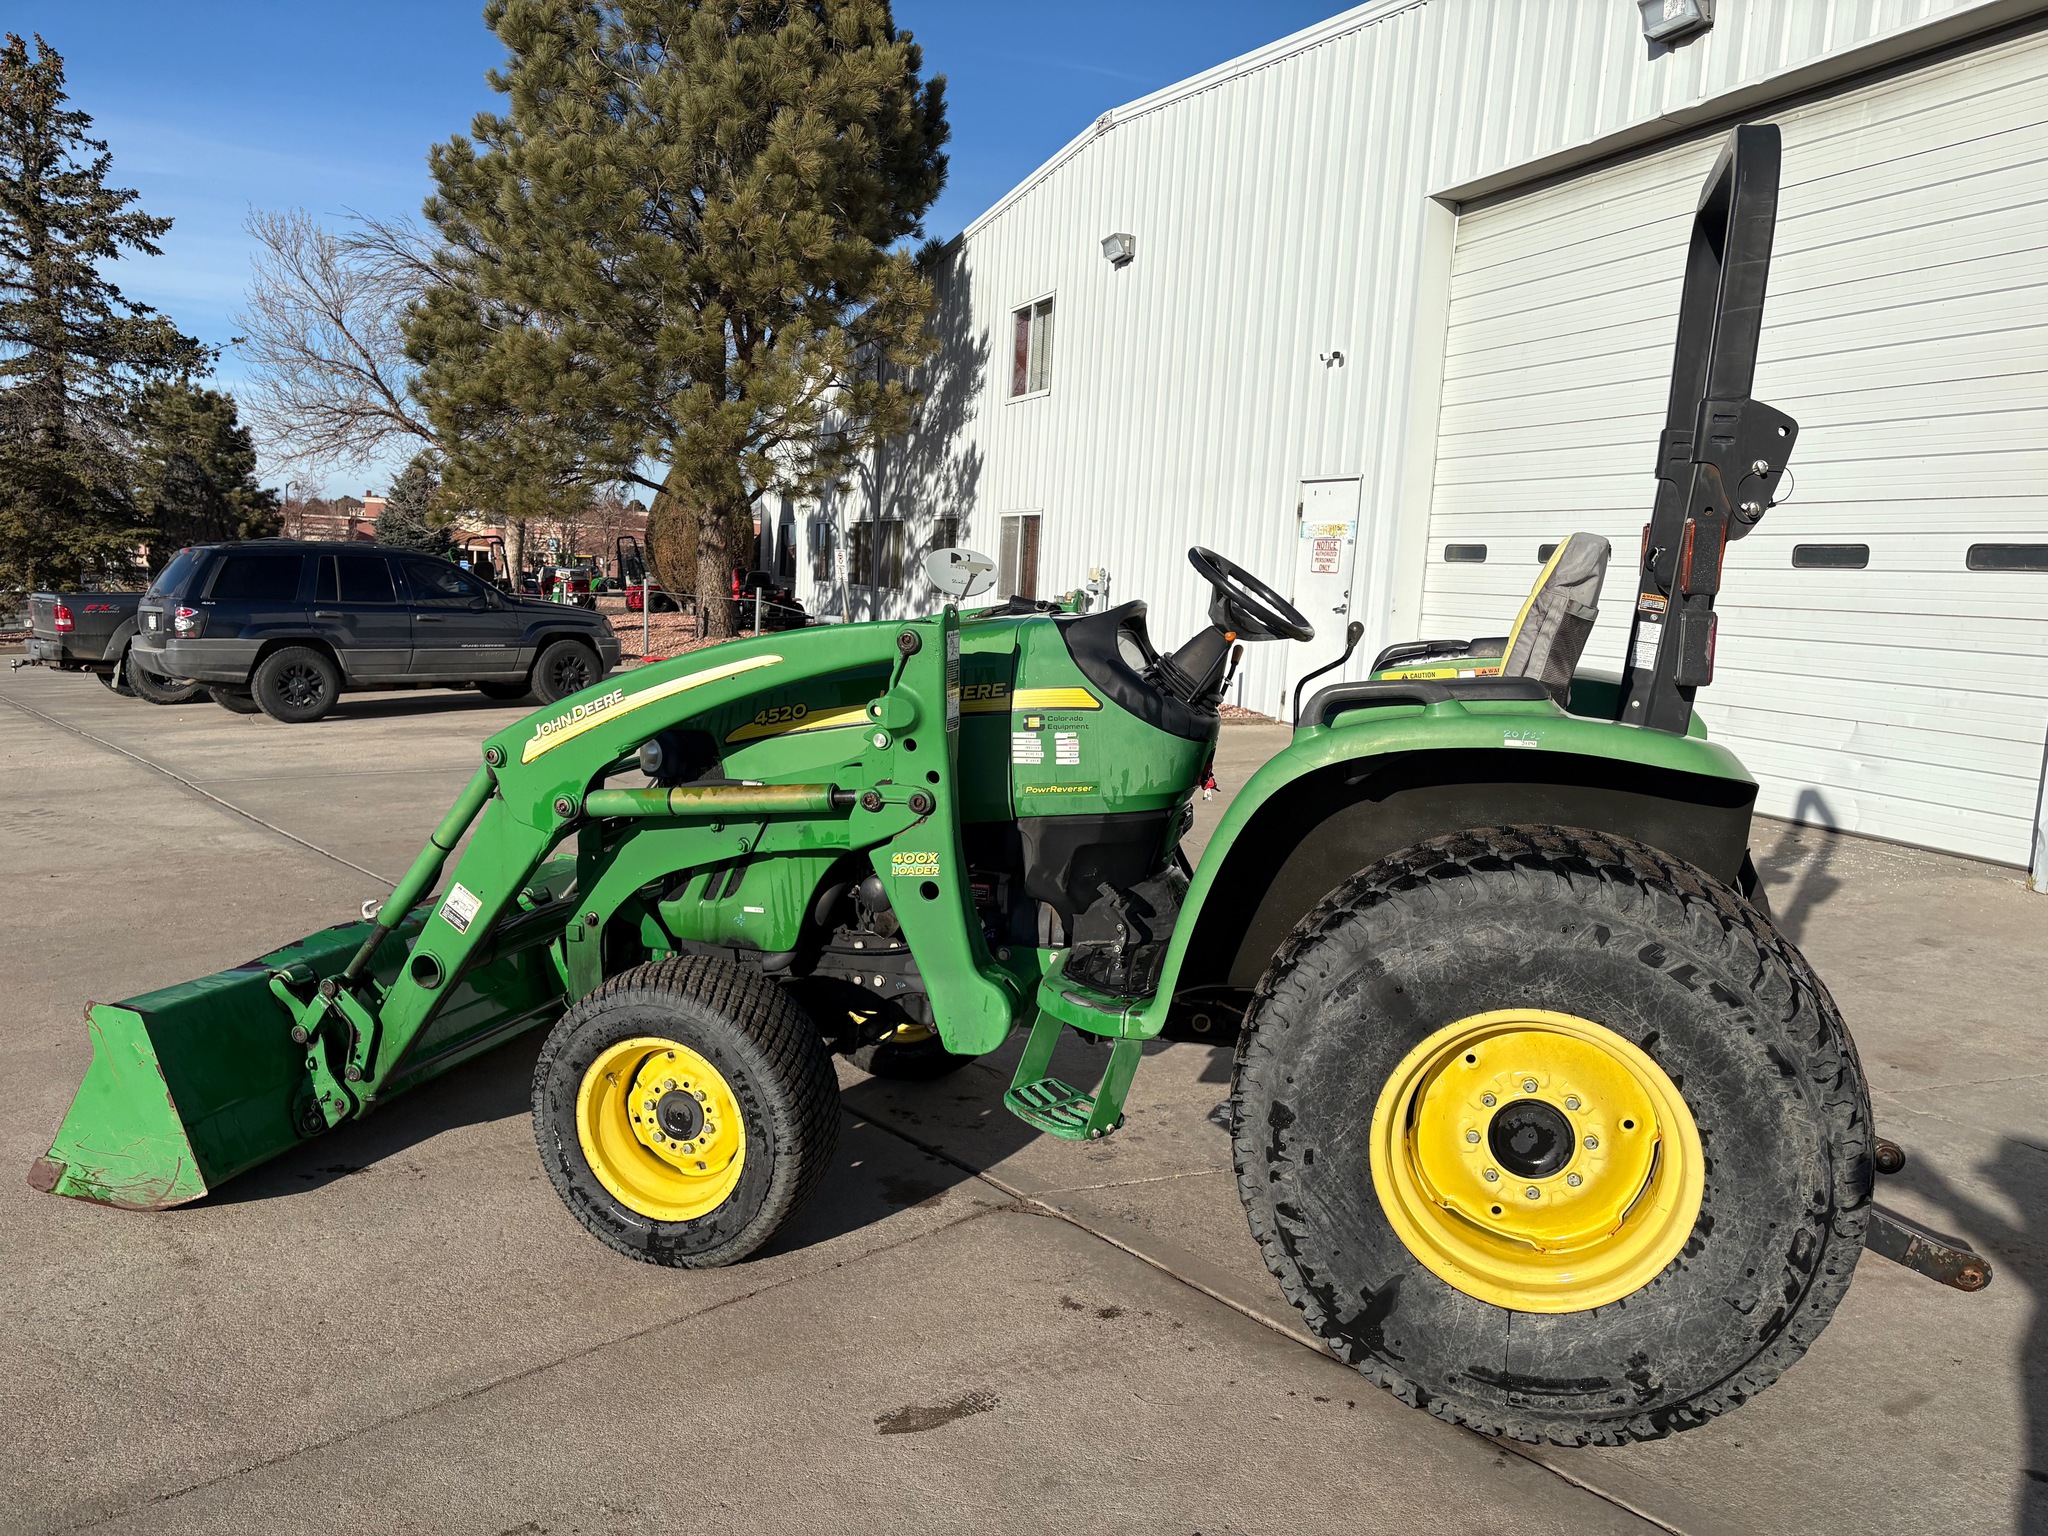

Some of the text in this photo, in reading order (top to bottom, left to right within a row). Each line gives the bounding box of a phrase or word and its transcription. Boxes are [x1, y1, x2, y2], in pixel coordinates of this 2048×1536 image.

[1316, 541, 1338, 550] NOTICE
[532, 688, 625, 741] JOHN DEERE
[754, 703, 808, 725] 4520
[1503, 730, 1519, 738] 20
[1025, 785, 1093, 794] PowrReverser
[892, 852, 939, 864] 400X
[892, 865, 940, 876] LOADER
